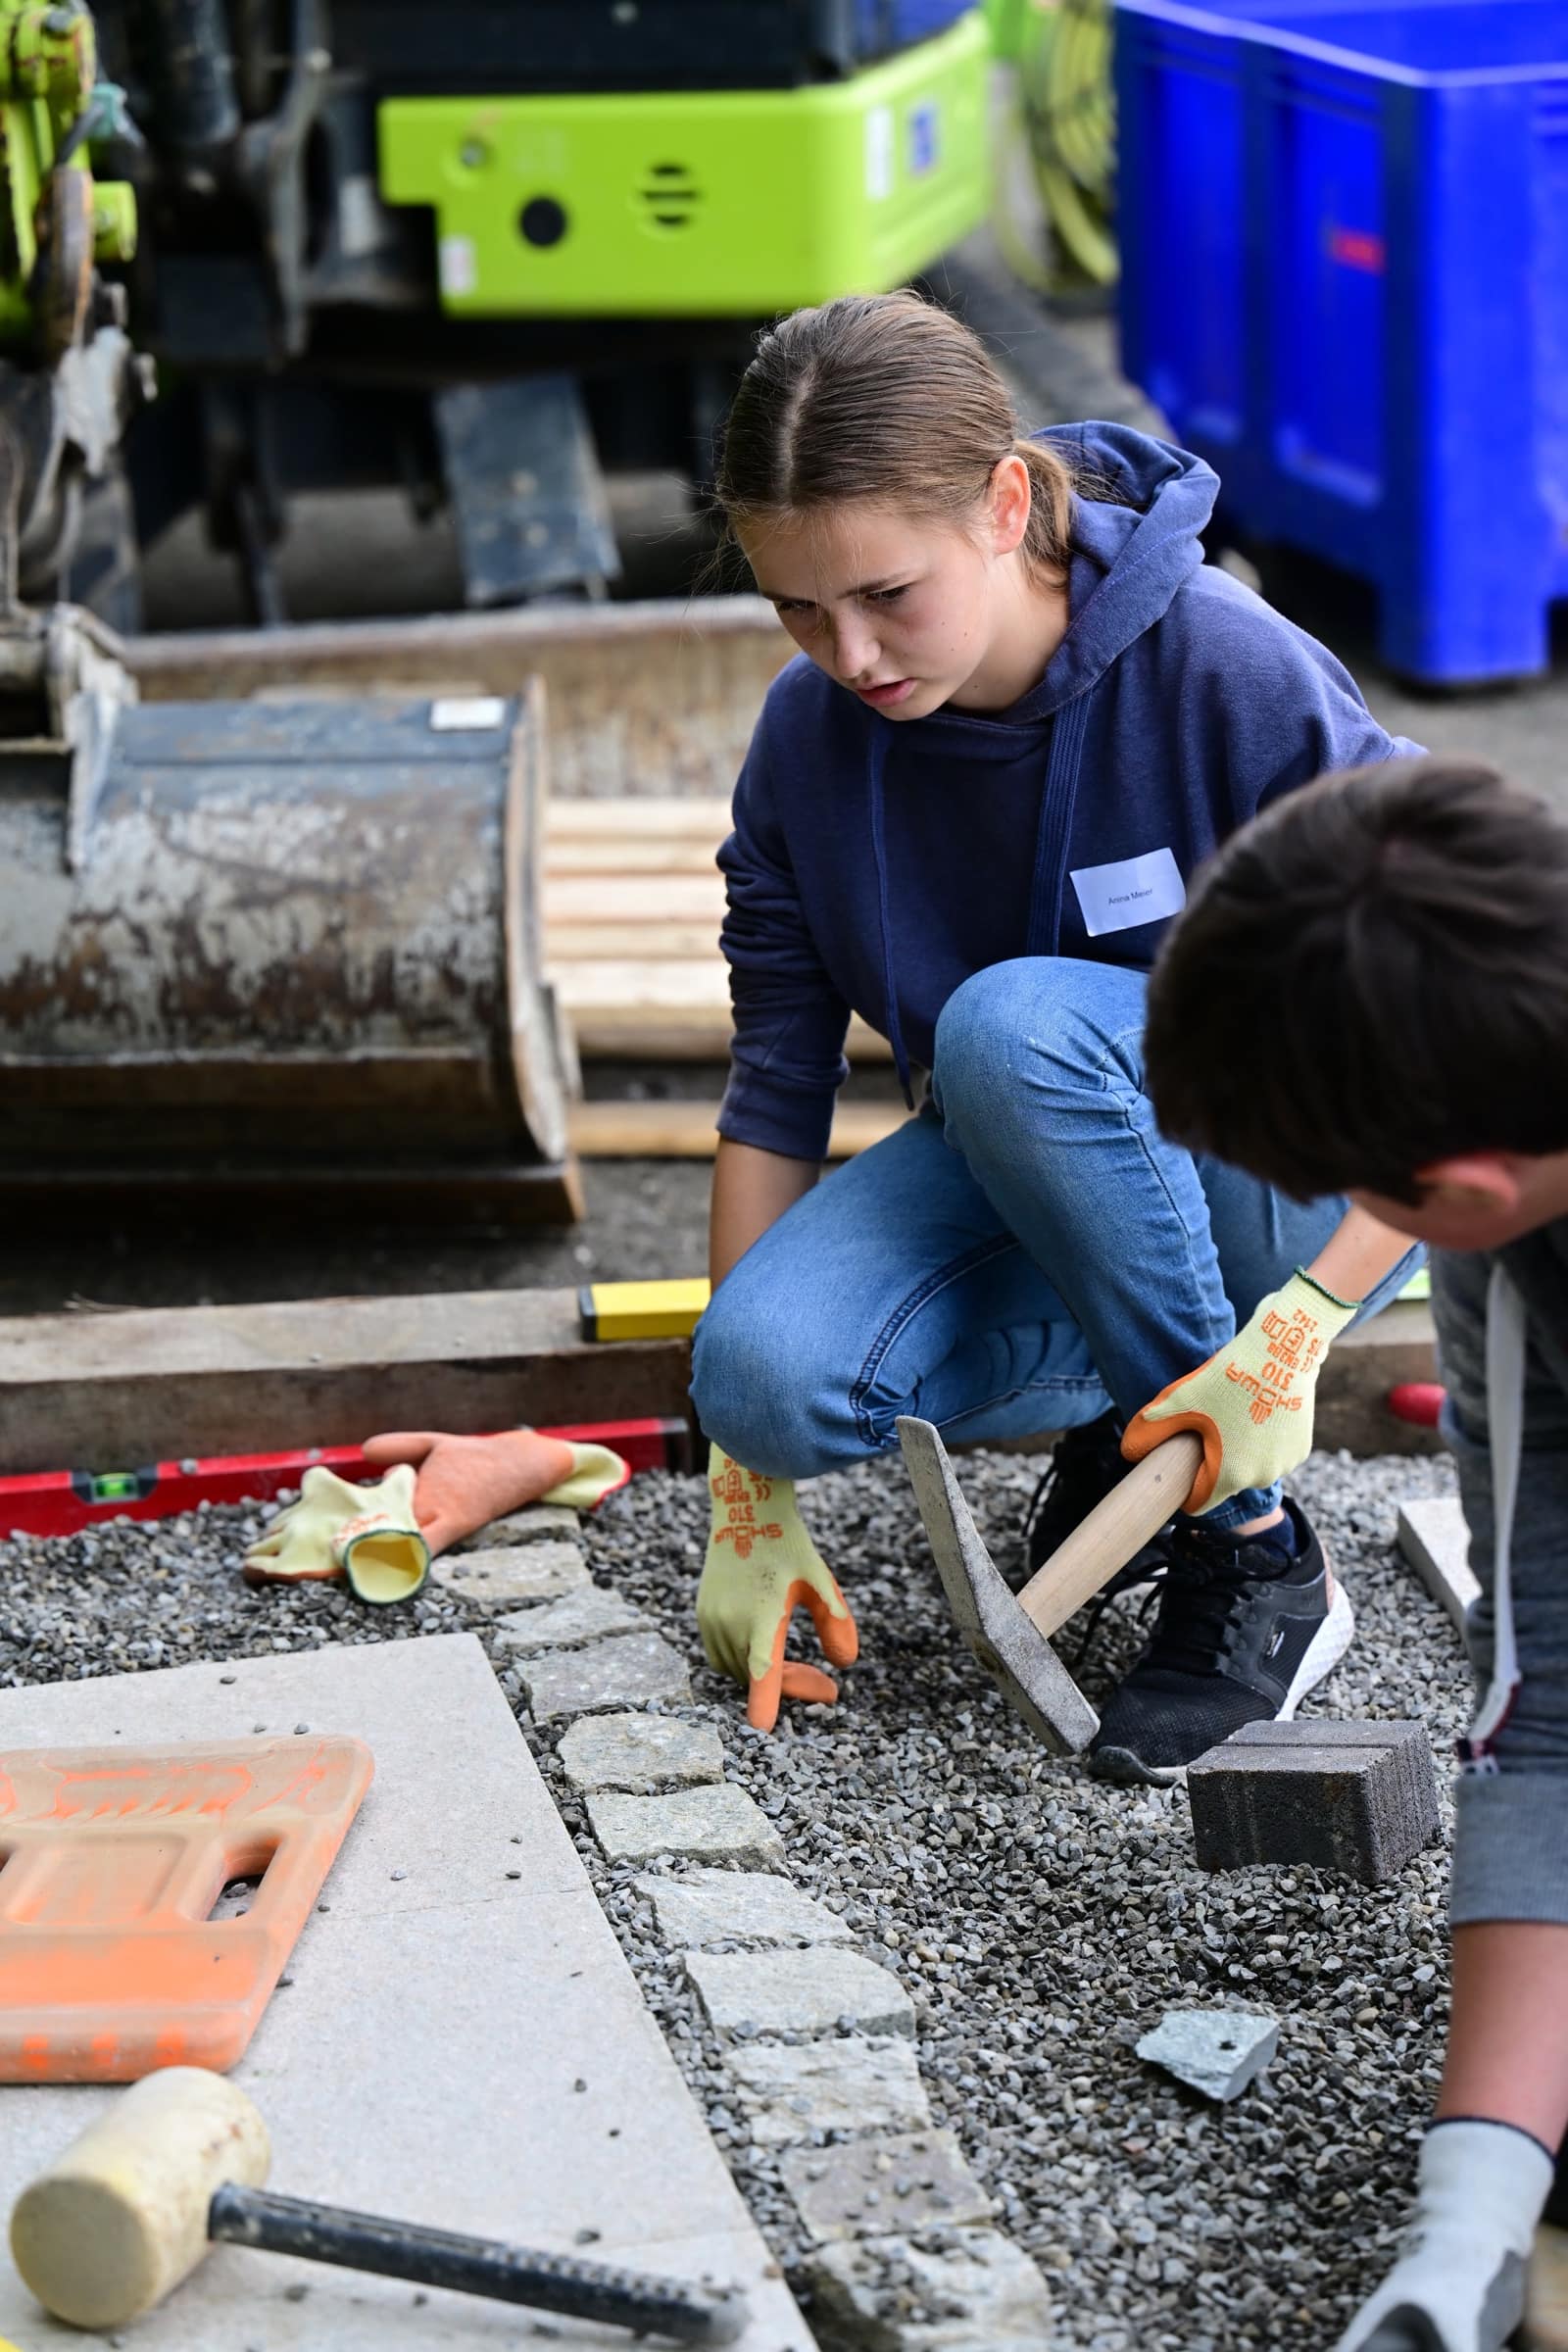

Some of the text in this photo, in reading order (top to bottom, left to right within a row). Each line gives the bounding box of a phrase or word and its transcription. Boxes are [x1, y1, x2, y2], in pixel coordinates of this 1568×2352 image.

[1225, 1361, 1303, 1411] SHOWA
[1261, 1361, 1294, 1391] 310
[728, 1504, 756, 1523] 310
